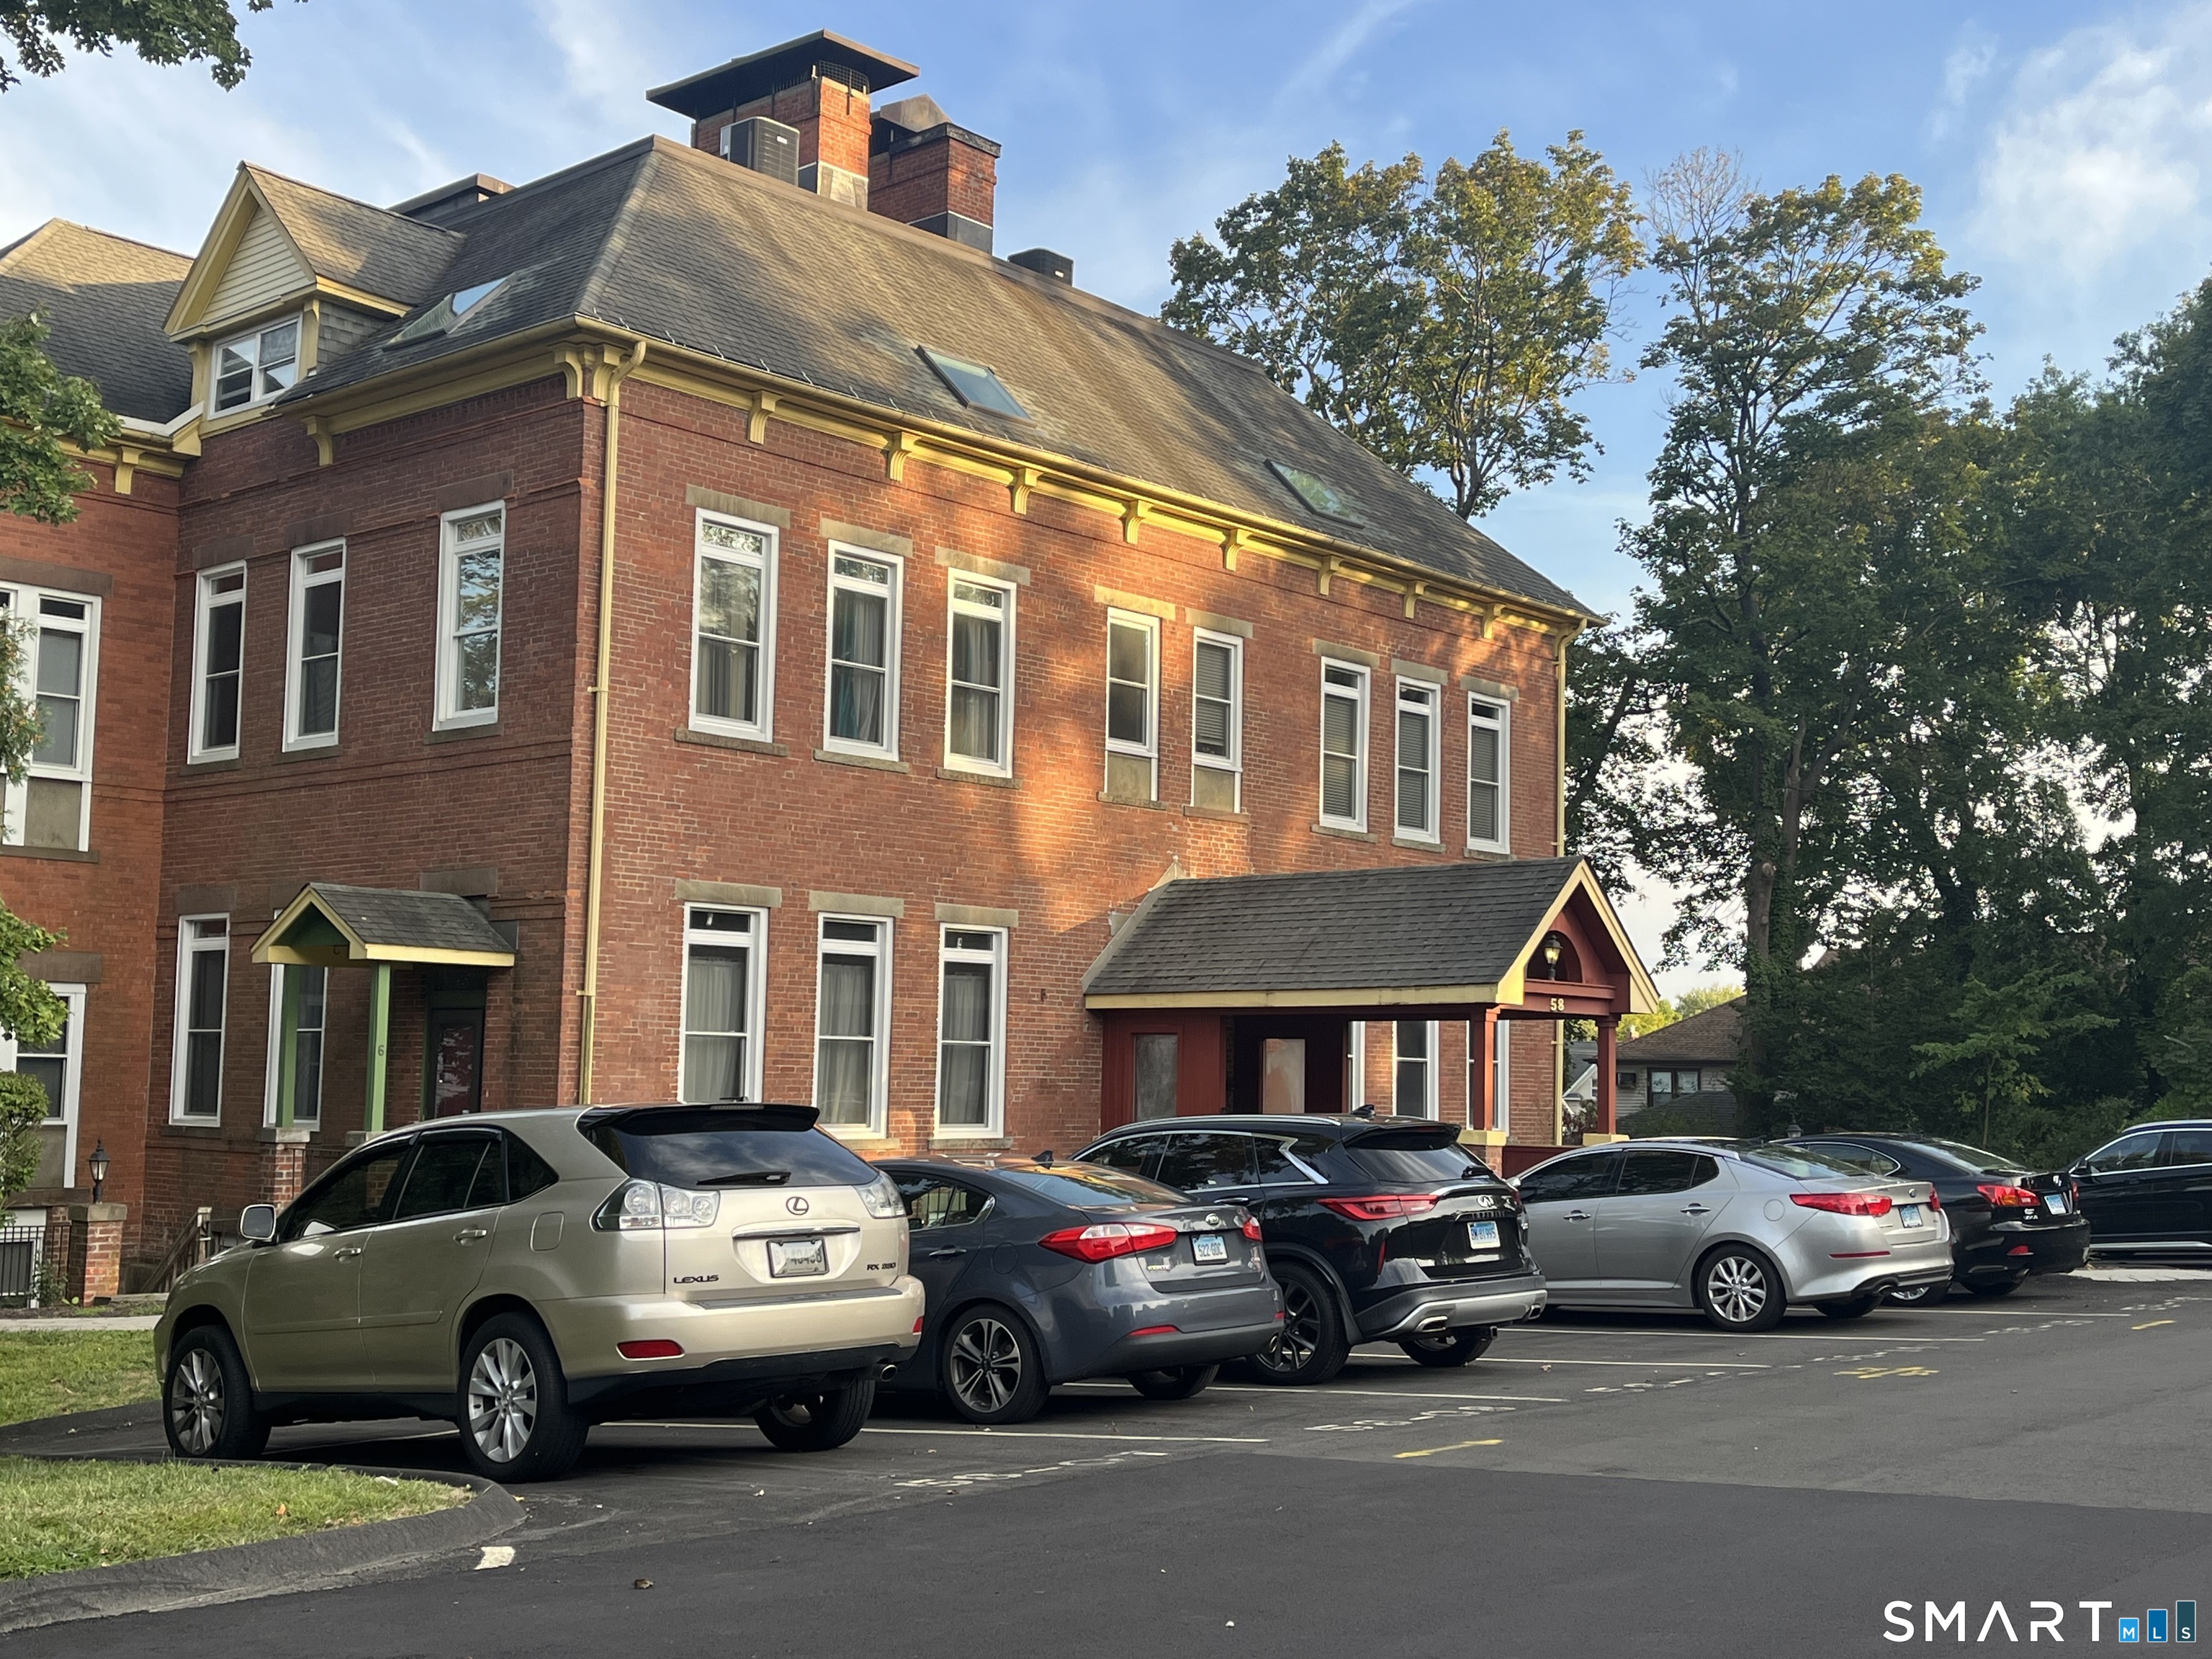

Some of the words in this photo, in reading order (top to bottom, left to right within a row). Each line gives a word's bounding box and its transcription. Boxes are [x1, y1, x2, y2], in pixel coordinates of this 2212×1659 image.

[1550, 998, 1565, 1011] 58
[378, 1045, 385, 1056] 6
[673, 1274, 719, 1284] LEXUS
